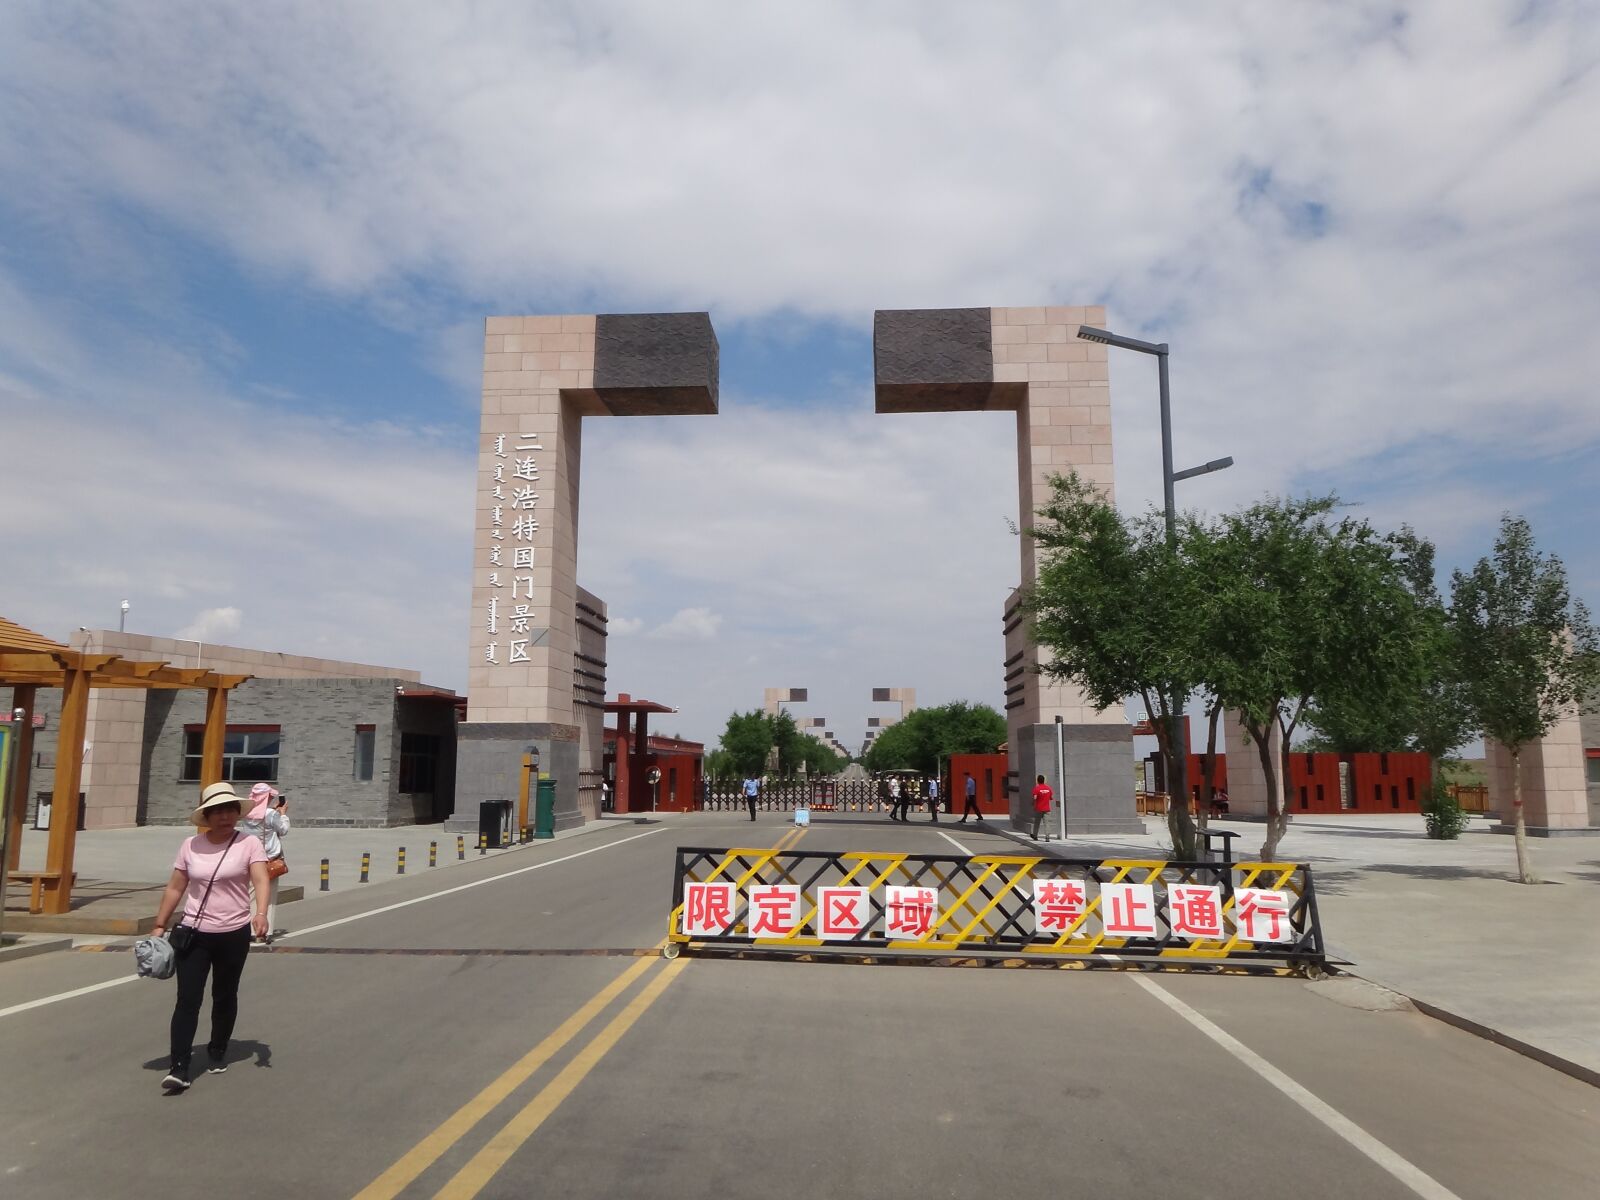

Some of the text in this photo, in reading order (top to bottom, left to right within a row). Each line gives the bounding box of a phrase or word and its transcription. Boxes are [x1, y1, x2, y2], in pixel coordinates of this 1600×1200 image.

[509, 433, 543, 663] 二连浩特国门景区
[686, 883, 1286, 939] 限定区域 禁止通行
